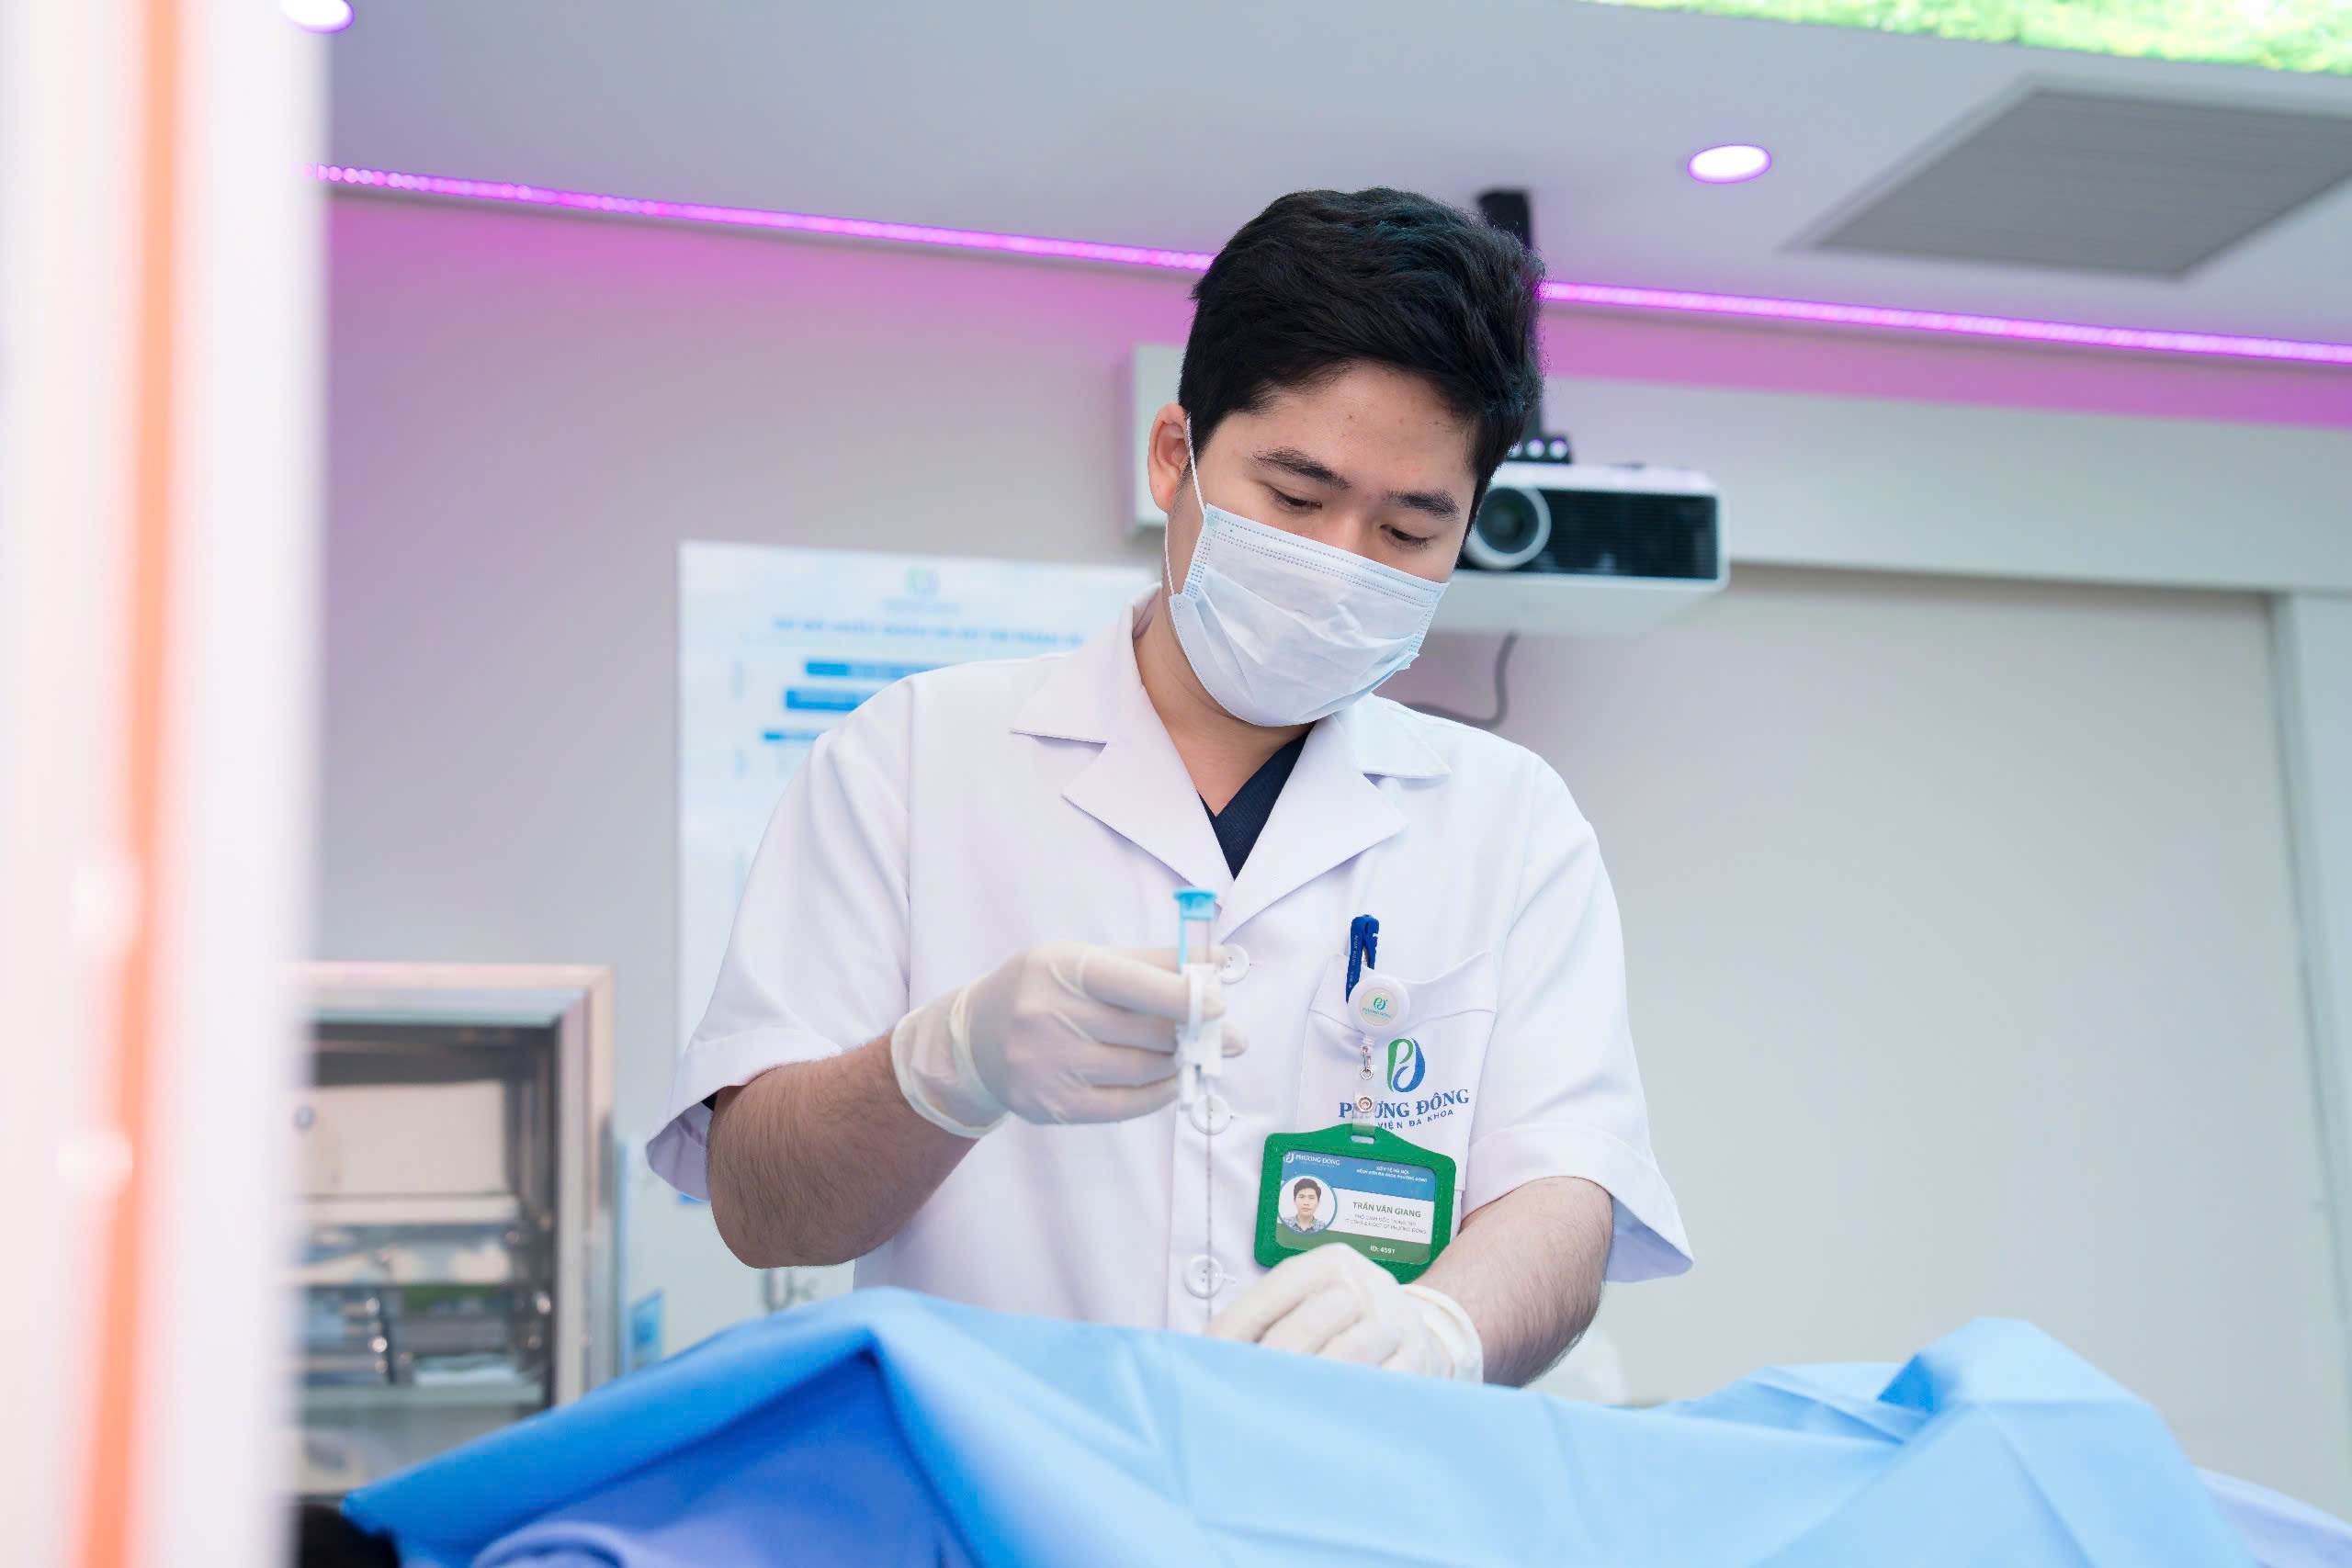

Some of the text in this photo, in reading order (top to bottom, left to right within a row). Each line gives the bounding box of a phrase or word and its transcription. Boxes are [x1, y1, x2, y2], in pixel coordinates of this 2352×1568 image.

[1416, 1089, 1469, 1115] ĐÔNG
[1378, 1121, 1403, 1130] VIỆN
[1428, 1110, 1453, 1122] KHOA
[1395, 1208, 1421, 1218] GIANG
